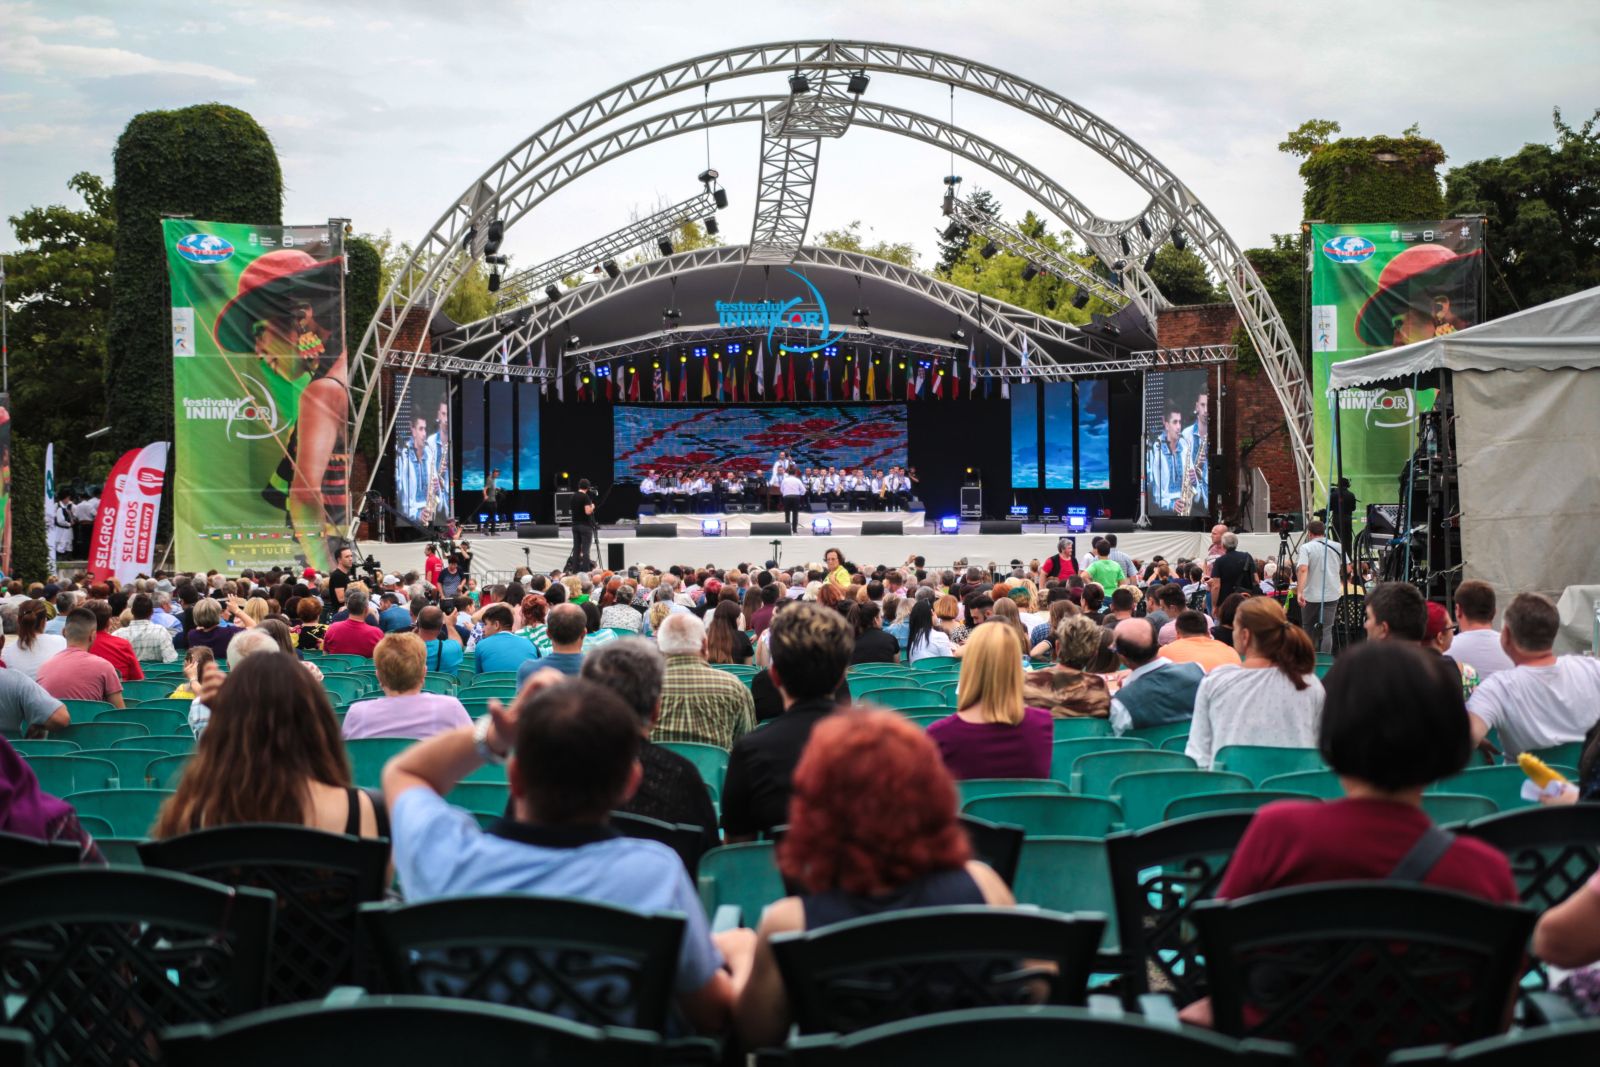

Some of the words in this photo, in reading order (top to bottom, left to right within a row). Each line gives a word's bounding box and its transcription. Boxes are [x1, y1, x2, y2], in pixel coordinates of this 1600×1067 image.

[715, 300, 784, 312] festivalul
[183, 397, 241, 407] festivalul
[142, 506, 153, 530] carry
[95, 506, 116, 568] SELGROS
[122, 501, 139, 562] SELGROS
[139, 539, 147, 560] cash
[262, 547, 292, 555] IULIE
